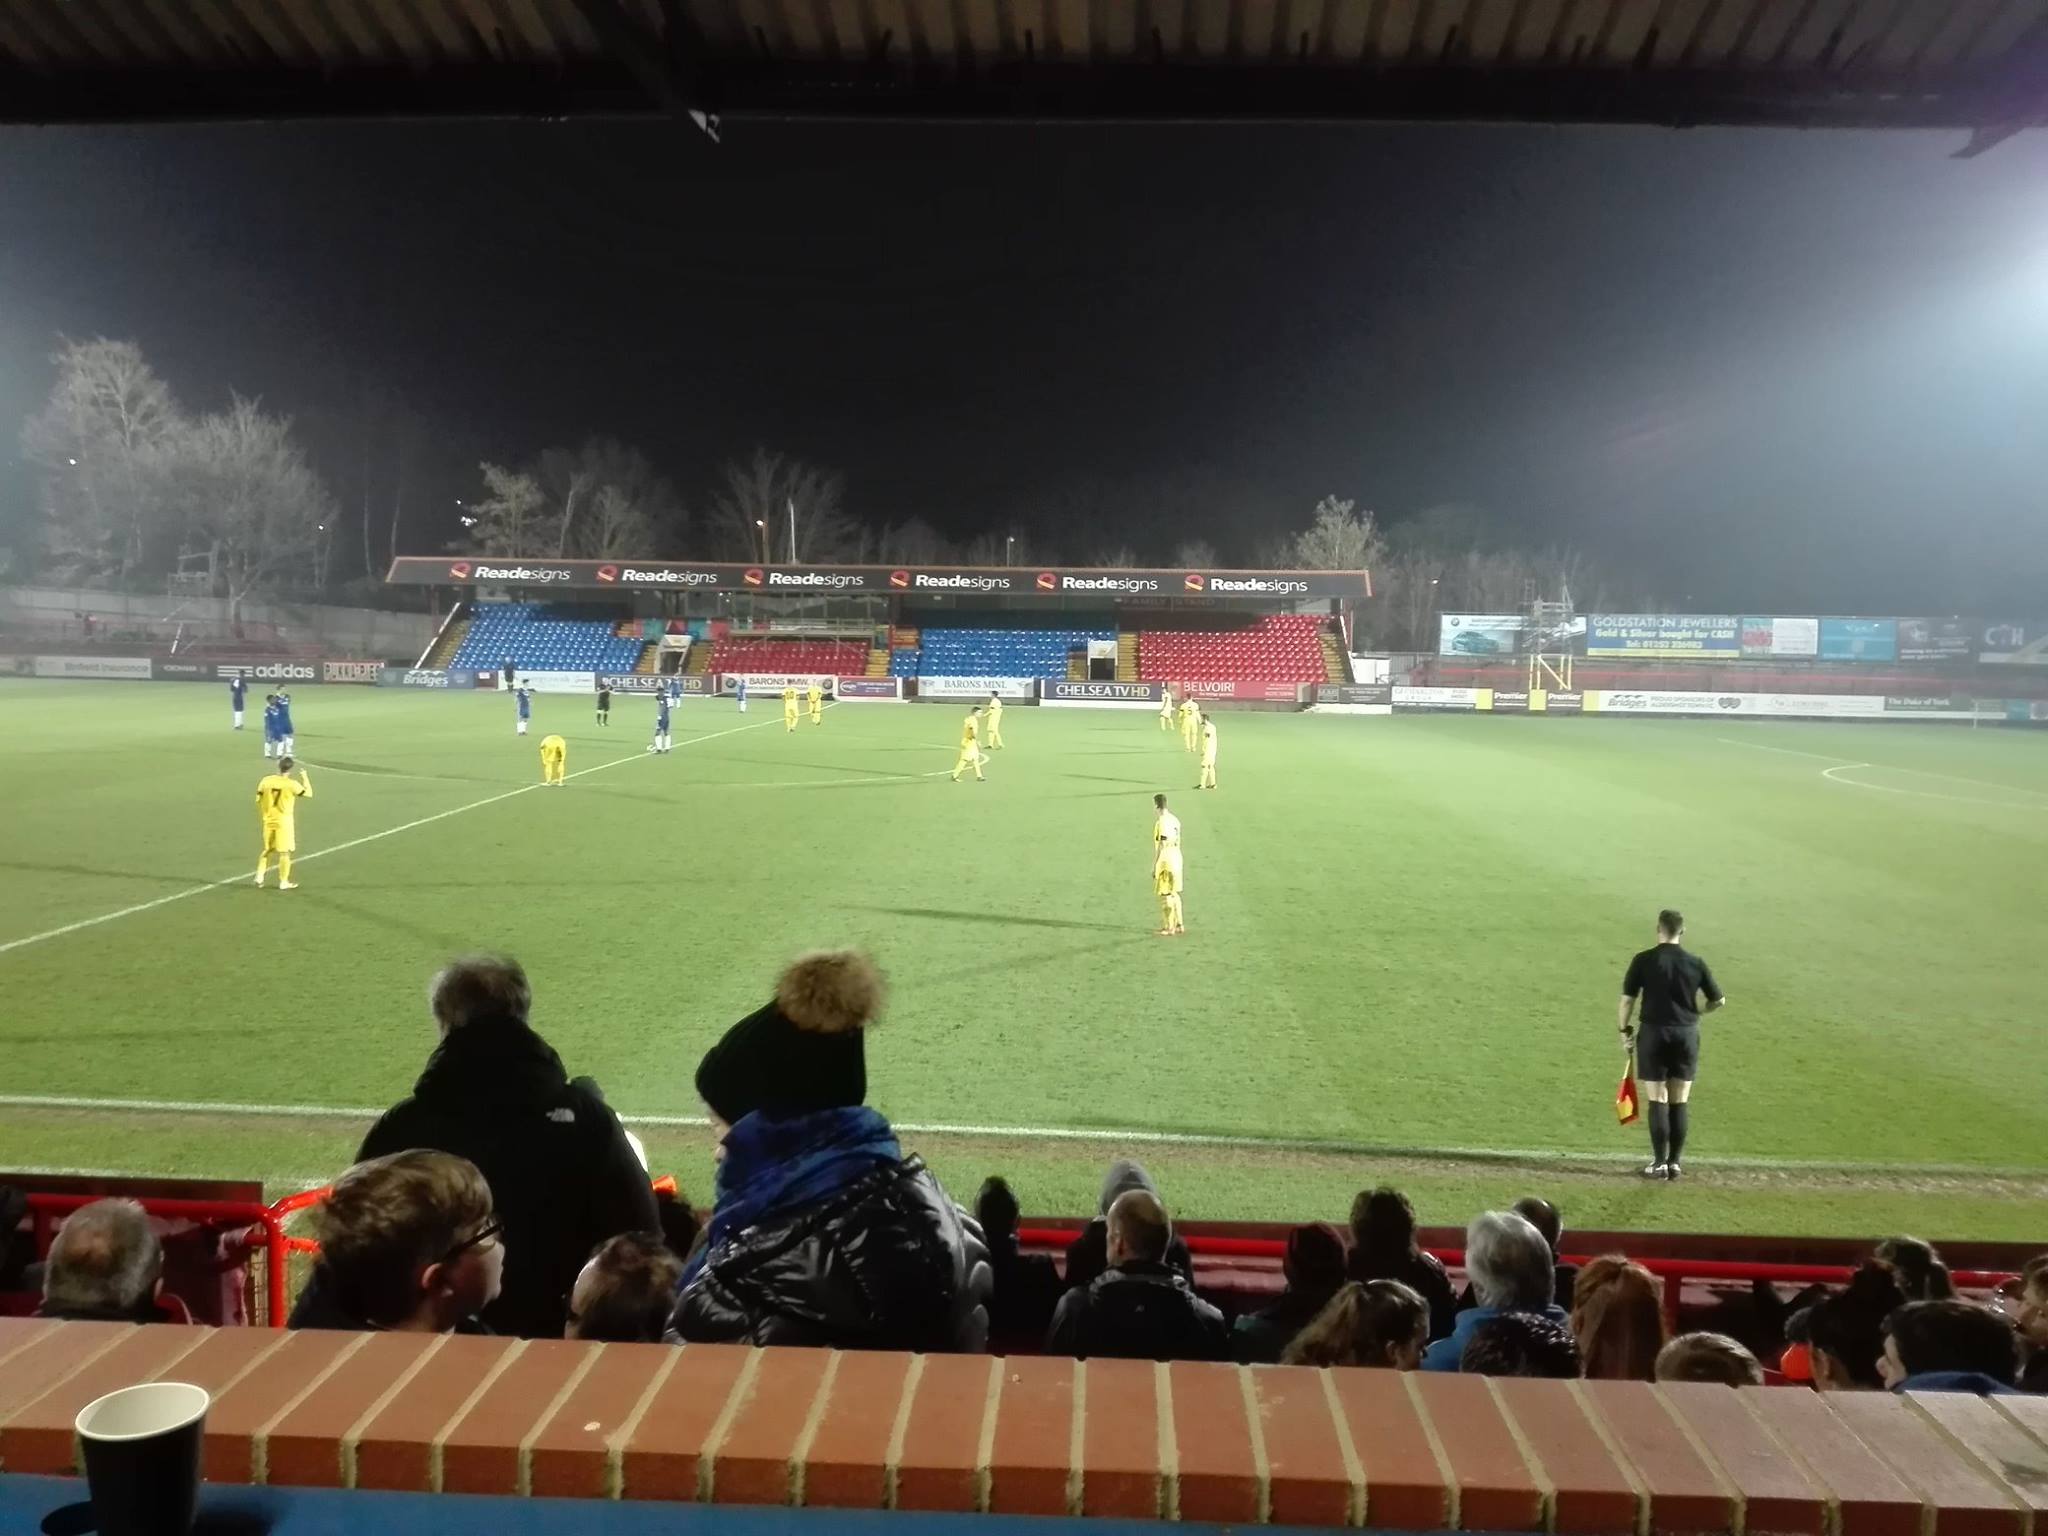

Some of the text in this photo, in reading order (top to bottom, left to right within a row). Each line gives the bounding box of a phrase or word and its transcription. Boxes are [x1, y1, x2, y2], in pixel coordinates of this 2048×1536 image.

[475, 566, 571, 583] Readesigns
[622, 568, 718, 585] Readesigns
[769, 571, 864, 588] Readesigns
[915, 574, 1010, 591] Readesigns
[1062, 576, 1158, 592] Readesigns
[1210, 578, 1308, 594] Readesigns
[1593, 617, 1738, 629] GOLDSTATION JEWELLERS
[1595, 630, 1619, 638] Gold
[1629, 630, 1657, 639] Silver
[1659, 630, 1693, 641] bought
[1711, 630, 1736, 639] CASH
[256, 664, 315, 679] adidas
[403, 674, 449, 687] Bridges
[609, 677, 664, 688] CHELSEA
[683, 679, 702, 690] HD
[944, 680, 982, 688] BARONS
[1184, 681, 1235, 692] BELVOIR!
[1056, 685, 1150, 697] CHELSEA TV HD
[1608, 698, 1647, 708] Bridges
[271, 788, 282, 807] 7
